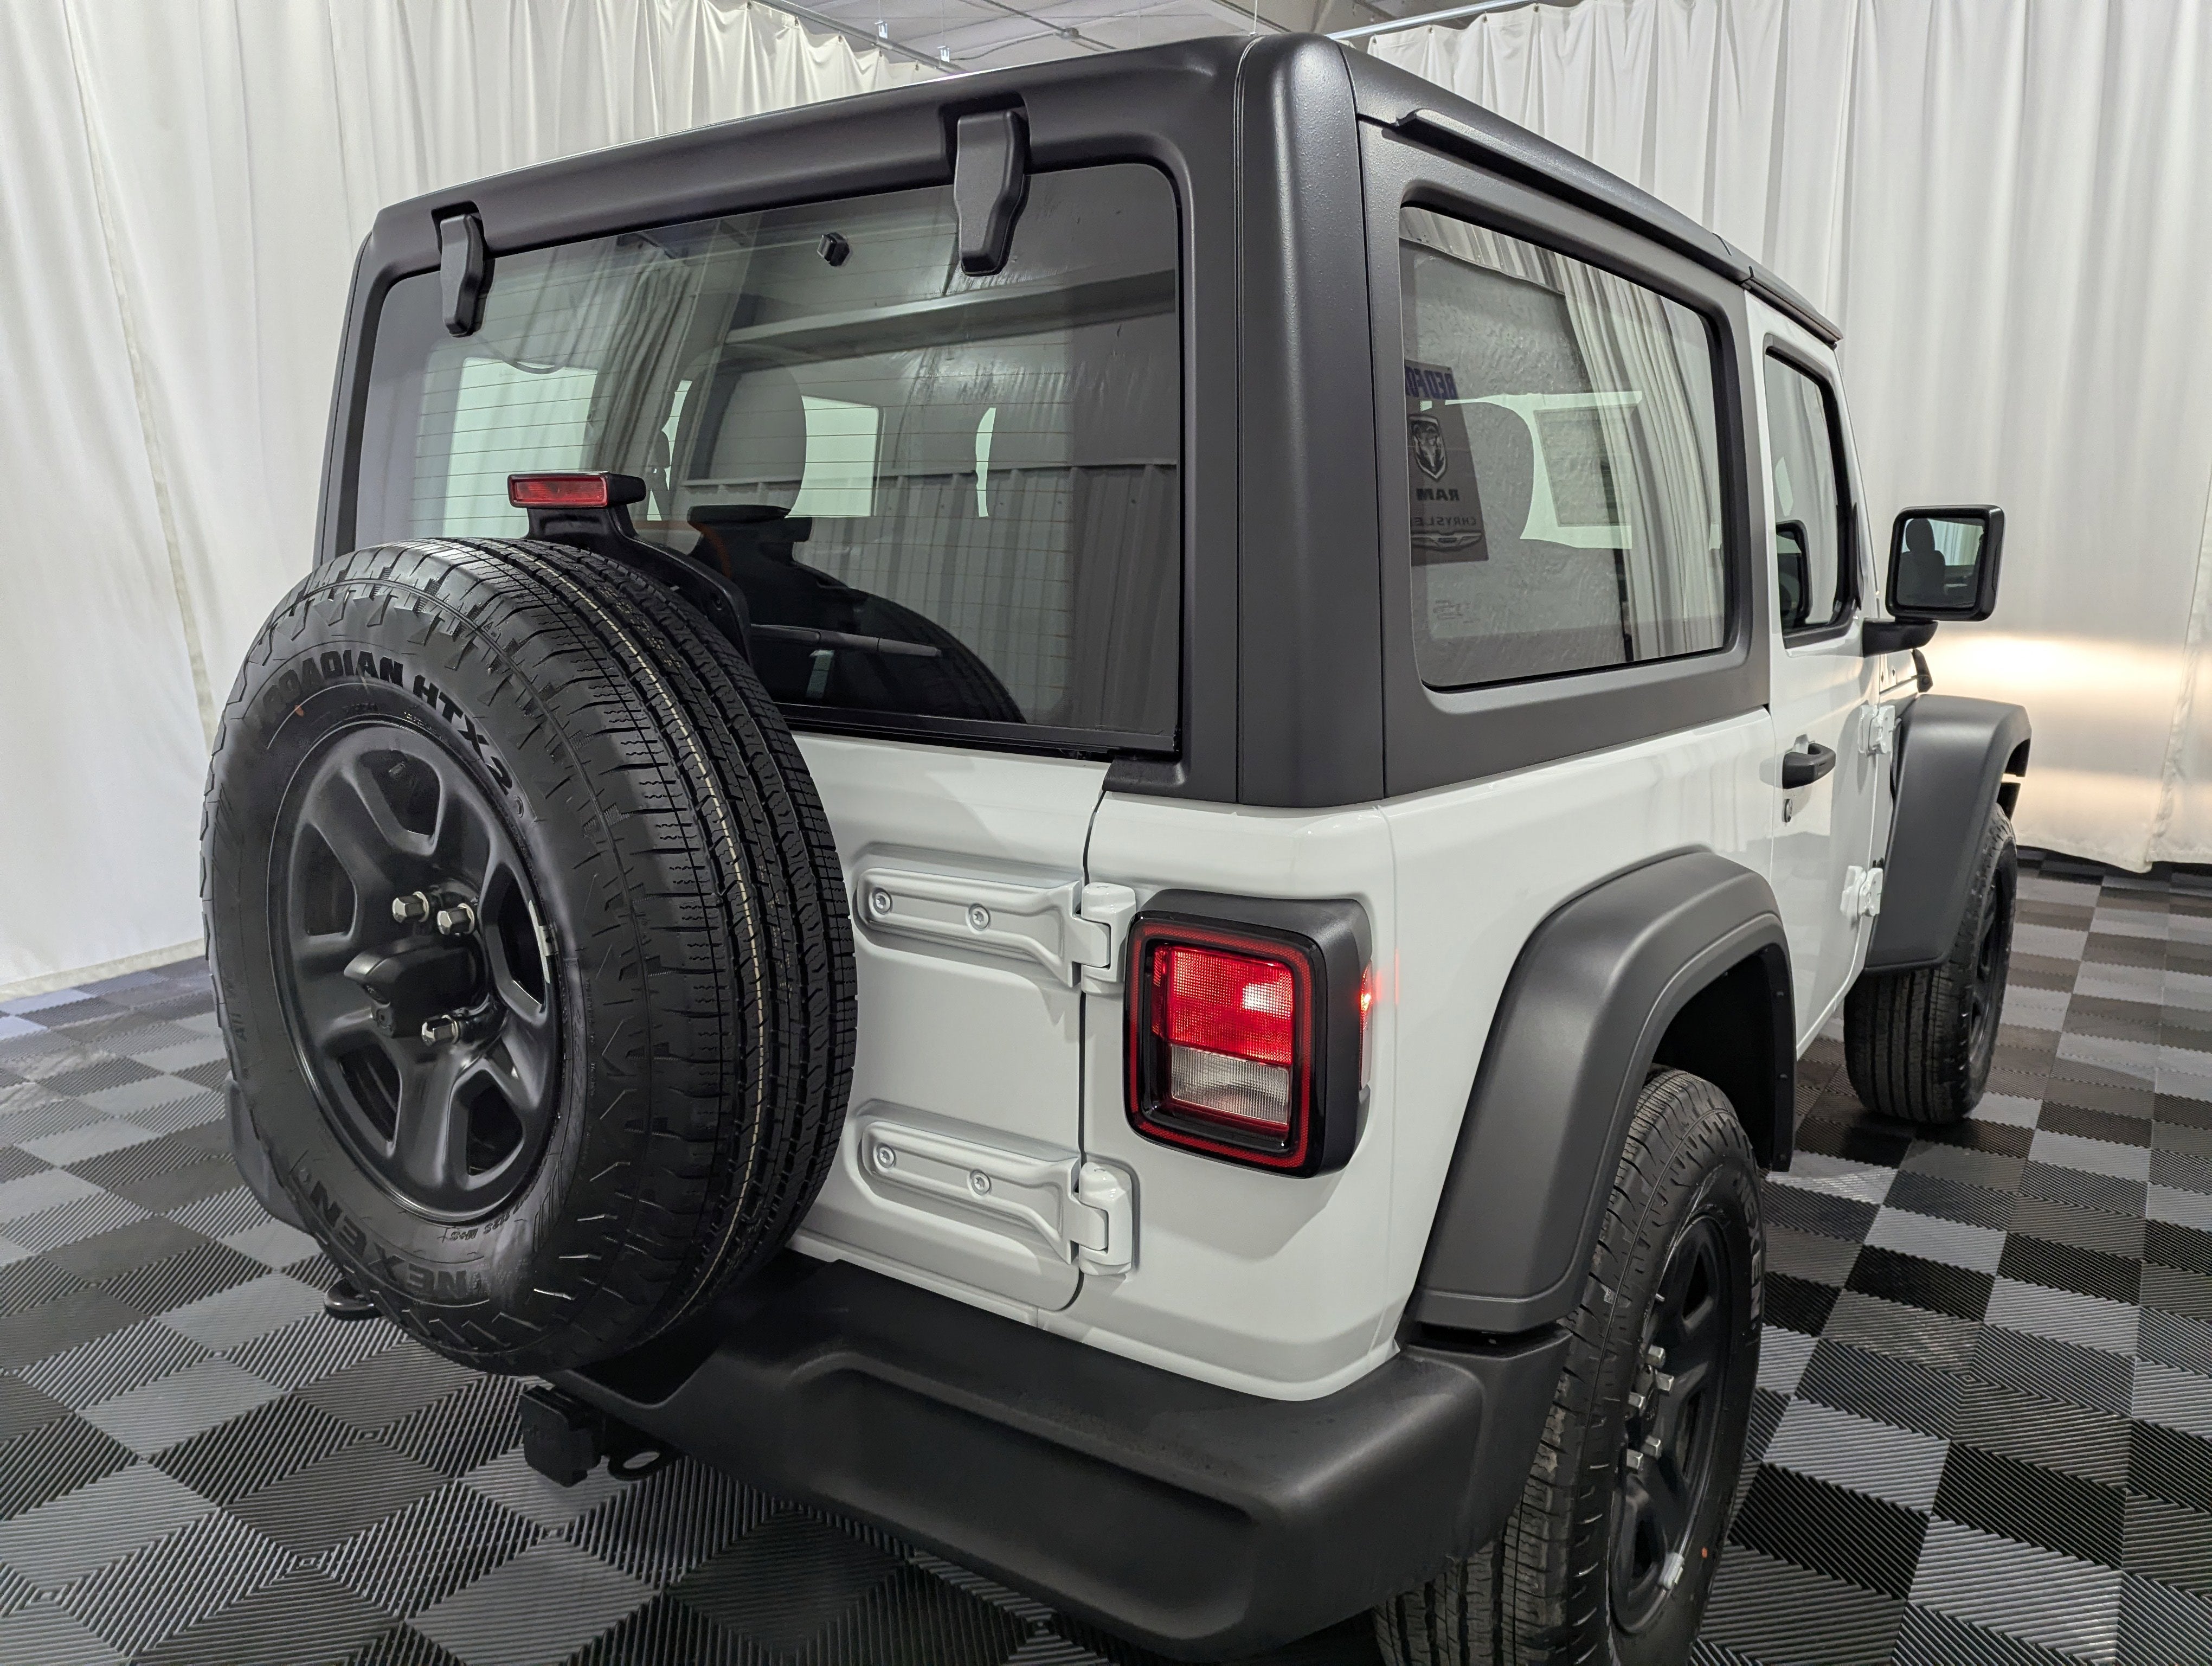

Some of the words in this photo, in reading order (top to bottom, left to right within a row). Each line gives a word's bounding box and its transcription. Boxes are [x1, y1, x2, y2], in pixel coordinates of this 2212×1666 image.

[262, 650, 403, 714] ROADIAN
[310, 1181, 466, 1298] NEXEN
[1737, 1175, 1762, 1322] NEXEN
